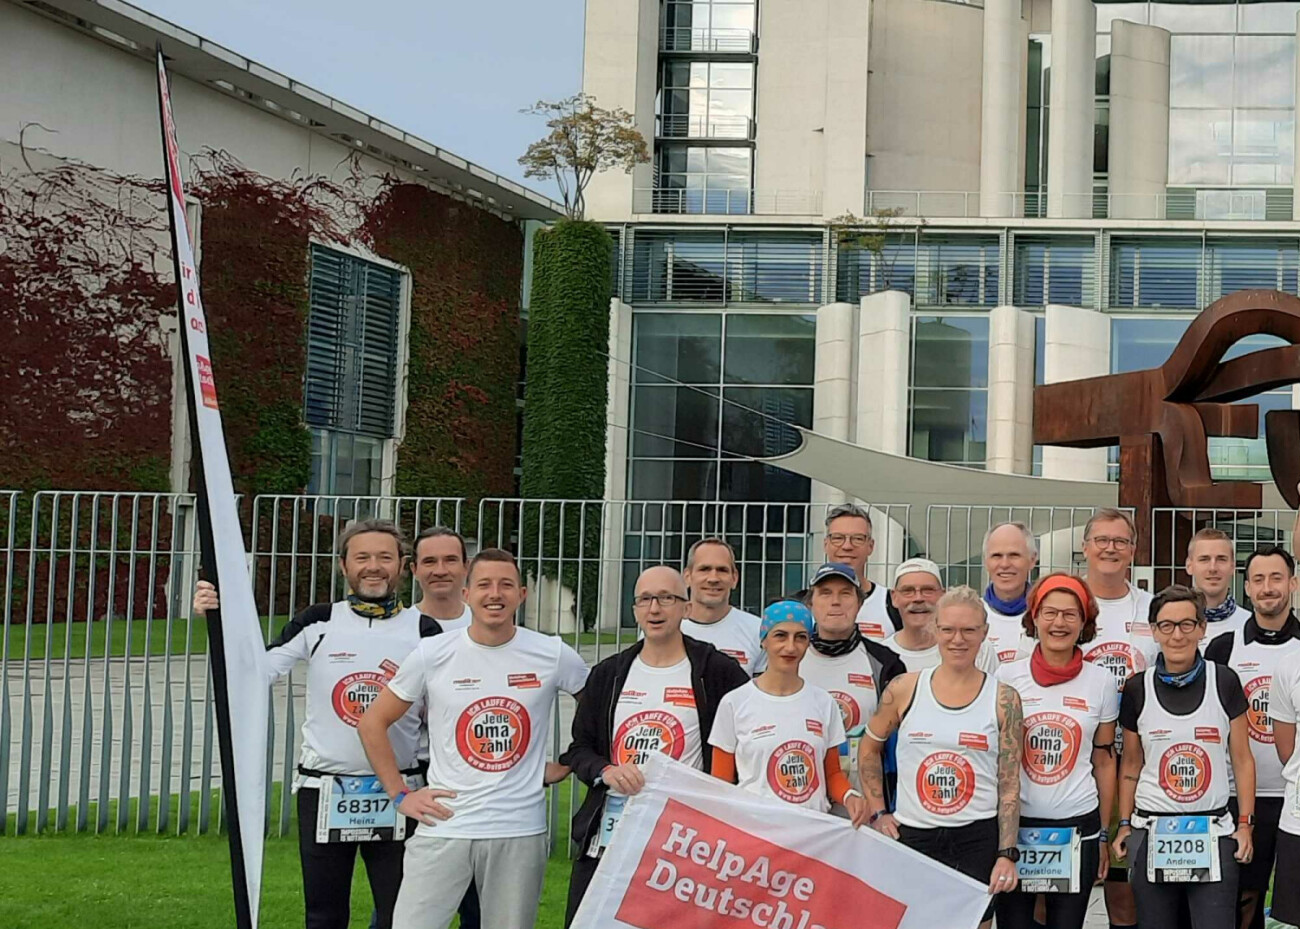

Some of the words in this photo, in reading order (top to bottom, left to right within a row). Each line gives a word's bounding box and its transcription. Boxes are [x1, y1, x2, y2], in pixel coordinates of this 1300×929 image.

[1103, 655, 1127, 665] Jede
[467, 705, 481, 717] ICH
[480, 698, 505, 708] LAUFE
[482, 713, 510, 725] Jede
[474, 723, 510, 739] Oma
[636, 727, 663, 737] Jede
[1038, 727, 1063, 737] Jede
[479, 738, 513, 754] zählt
[624, 735, 660, 751] Oma
[1030, 735, 1062, 751] Oma
[1033, 752, 1062, 766] zählt
[780, 763, 805, 776] Oma
[934, 766, 956, 775] Jede
[1170, 764, 1195, 776] Oma
[928, 774, 956, 787] Oma
[932, 787, 958, 799] zählt
[337, 799, 390, 814] 68317
[349, 817, 376, 825] Heinz
[1158, 839, 1205, 854] 21208
[661, 821, 815, 901] HelpAge
[1020, 850, 1062, 864] 13771
[1020, 867, 1062, 876] Christiane
